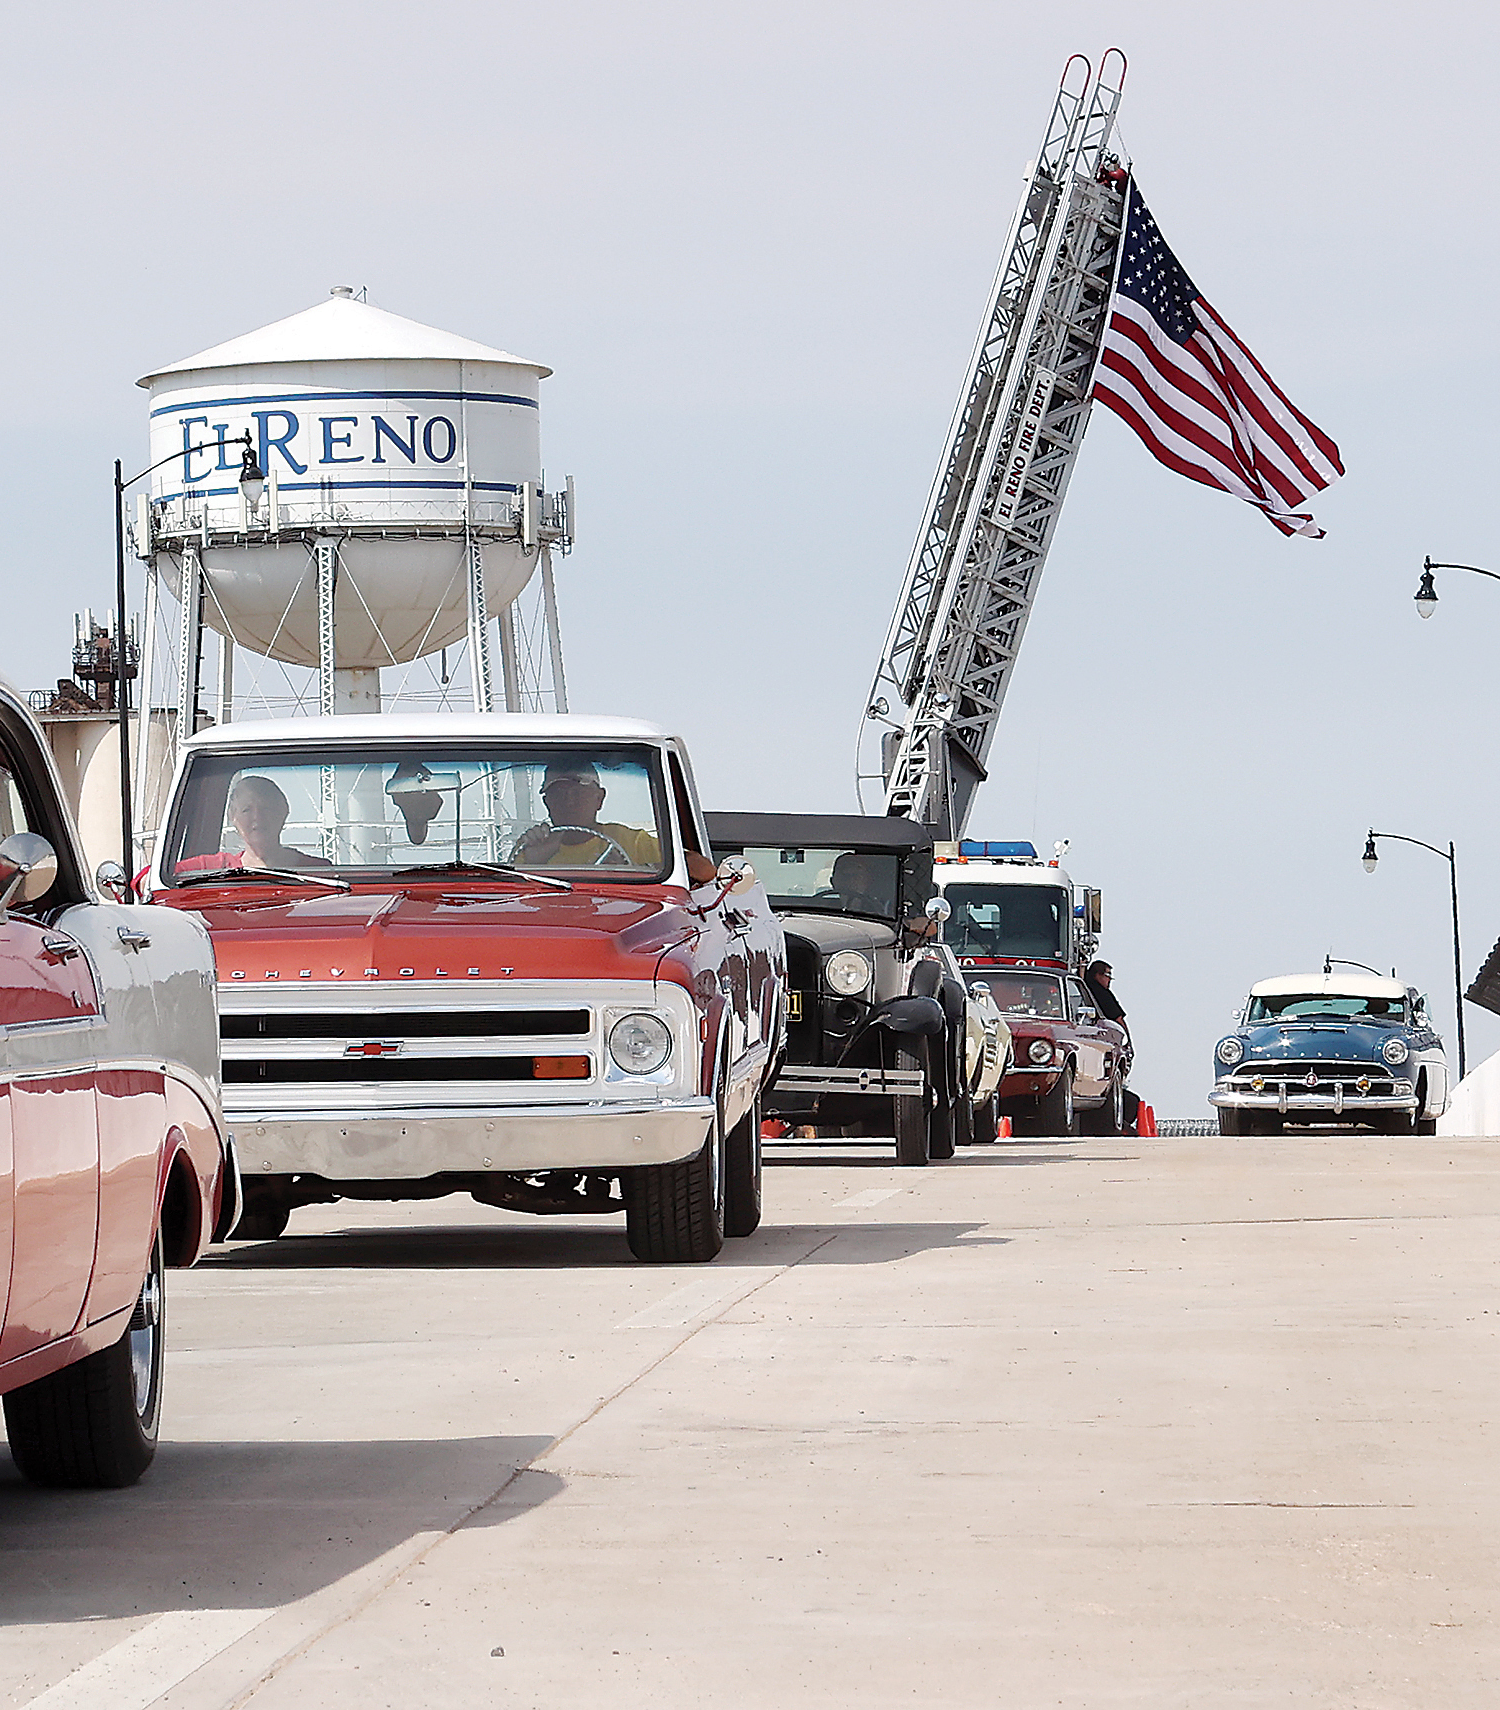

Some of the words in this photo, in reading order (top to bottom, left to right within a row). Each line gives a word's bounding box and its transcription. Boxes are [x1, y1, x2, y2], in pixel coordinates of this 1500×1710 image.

[1029, 379, 1051, 418] DEPT.
[251, 410, 456, 475] RENO
[1019, 422, 1037, 452] FIRE
[1005, 457, 1026, 498] RENO
[999, 502, 1013, 519] EL
[231, 967, 514, 978] CHEVROLET
